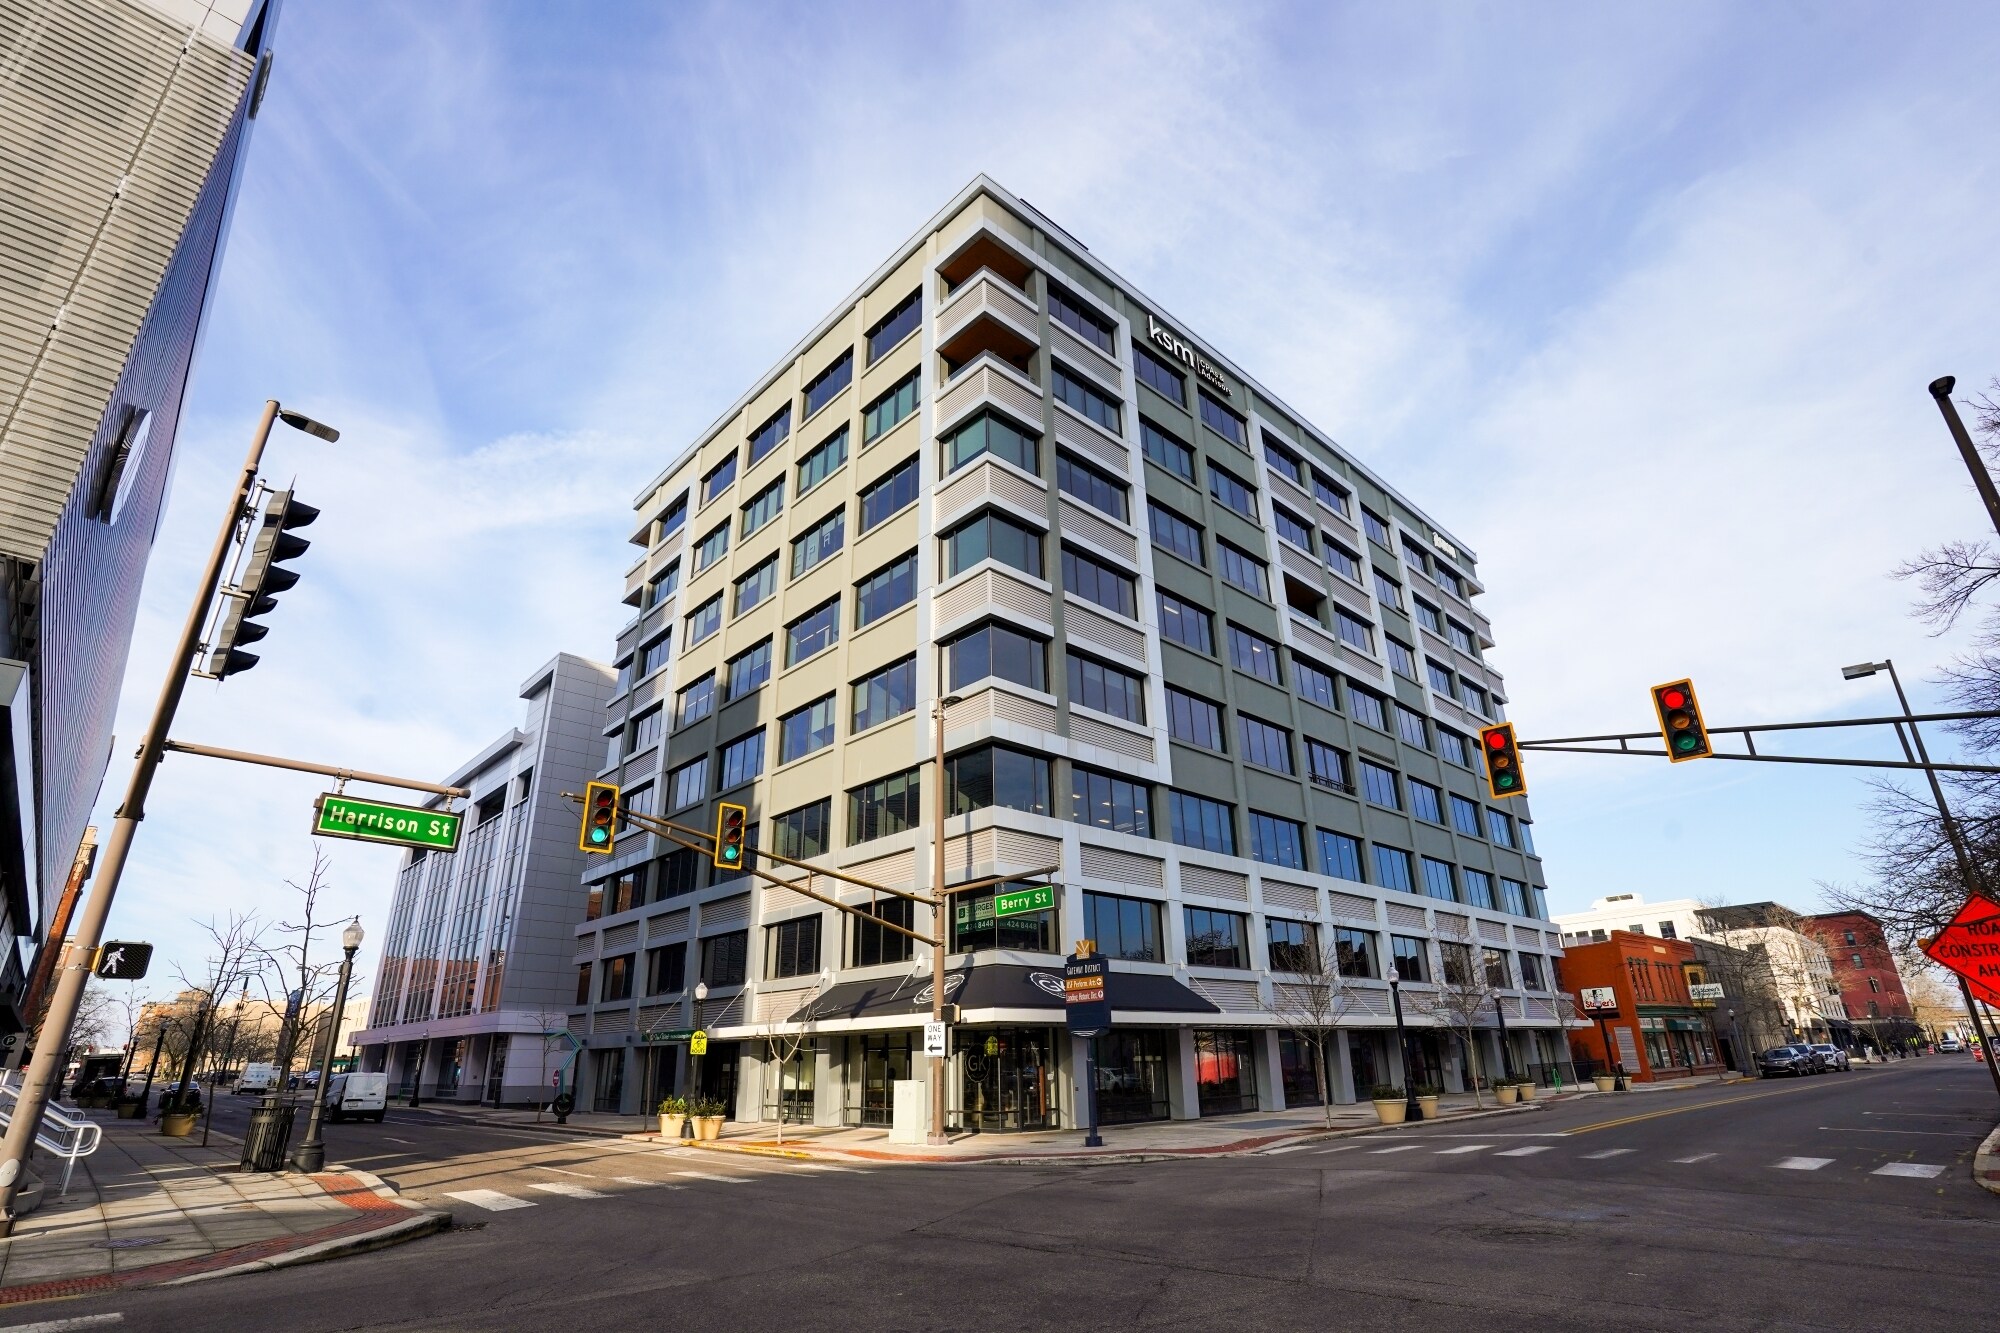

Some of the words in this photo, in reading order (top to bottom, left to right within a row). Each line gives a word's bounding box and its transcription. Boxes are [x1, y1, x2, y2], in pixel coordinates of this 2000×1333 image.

[1148, 315, 1195, 368] ksm
[1201, 369, 1233, 396] Advisors
[329, 805, 419, 834] Harrison
[428, 820, 451, 838] St
[1001, 896, 1030, 910] Berry
[1035, 892, 1047, 904] St
[977, 920, 994, 929] 8448
[1006, 920, 1019, 928] 424
[1939, 943, 2000, 959] CONSTR
[927, 1024, 941, 1033] ONE
[6, 1037, 14, 1045] P
[927, 1034, 942, 1042] WAY
[968, 1055, 986, 1071] GK
